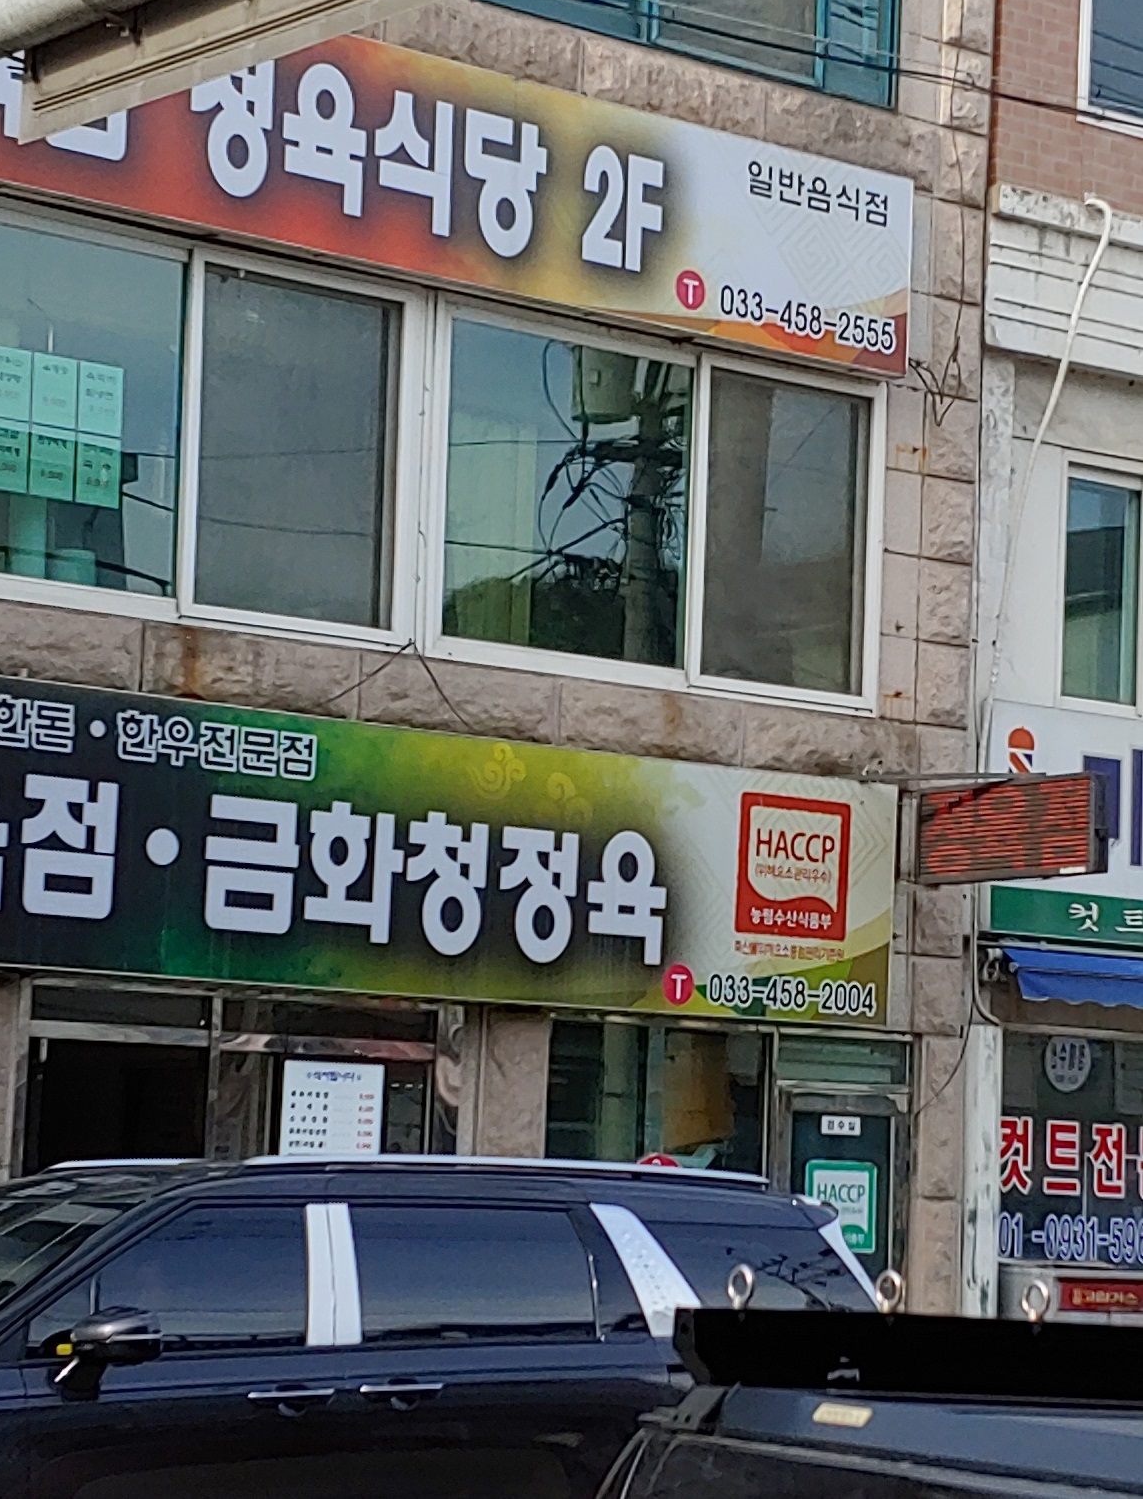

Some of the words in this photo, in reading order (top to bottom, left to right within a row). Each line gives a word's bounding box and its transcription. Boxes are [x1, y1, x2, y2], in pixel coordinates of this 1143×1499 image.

[581, 145, 664, 272] 2F
[747, 160, 889, 228] 일반음식점
[720, 284, 894, 351] 033-458-2555
[116, 710, 318, 782] 한우전문점
[755, 827, 836, 864] HACCP
[204, 793, 668, 966] 금화청정육
[750, 906, 833, 930] 농림수산식품부
[709, 973, 875, 1014] 033-458-2004
[1000, 1116, 1143, 1199] 컷트전
[816, 1182, 866, 1203] HACCP
